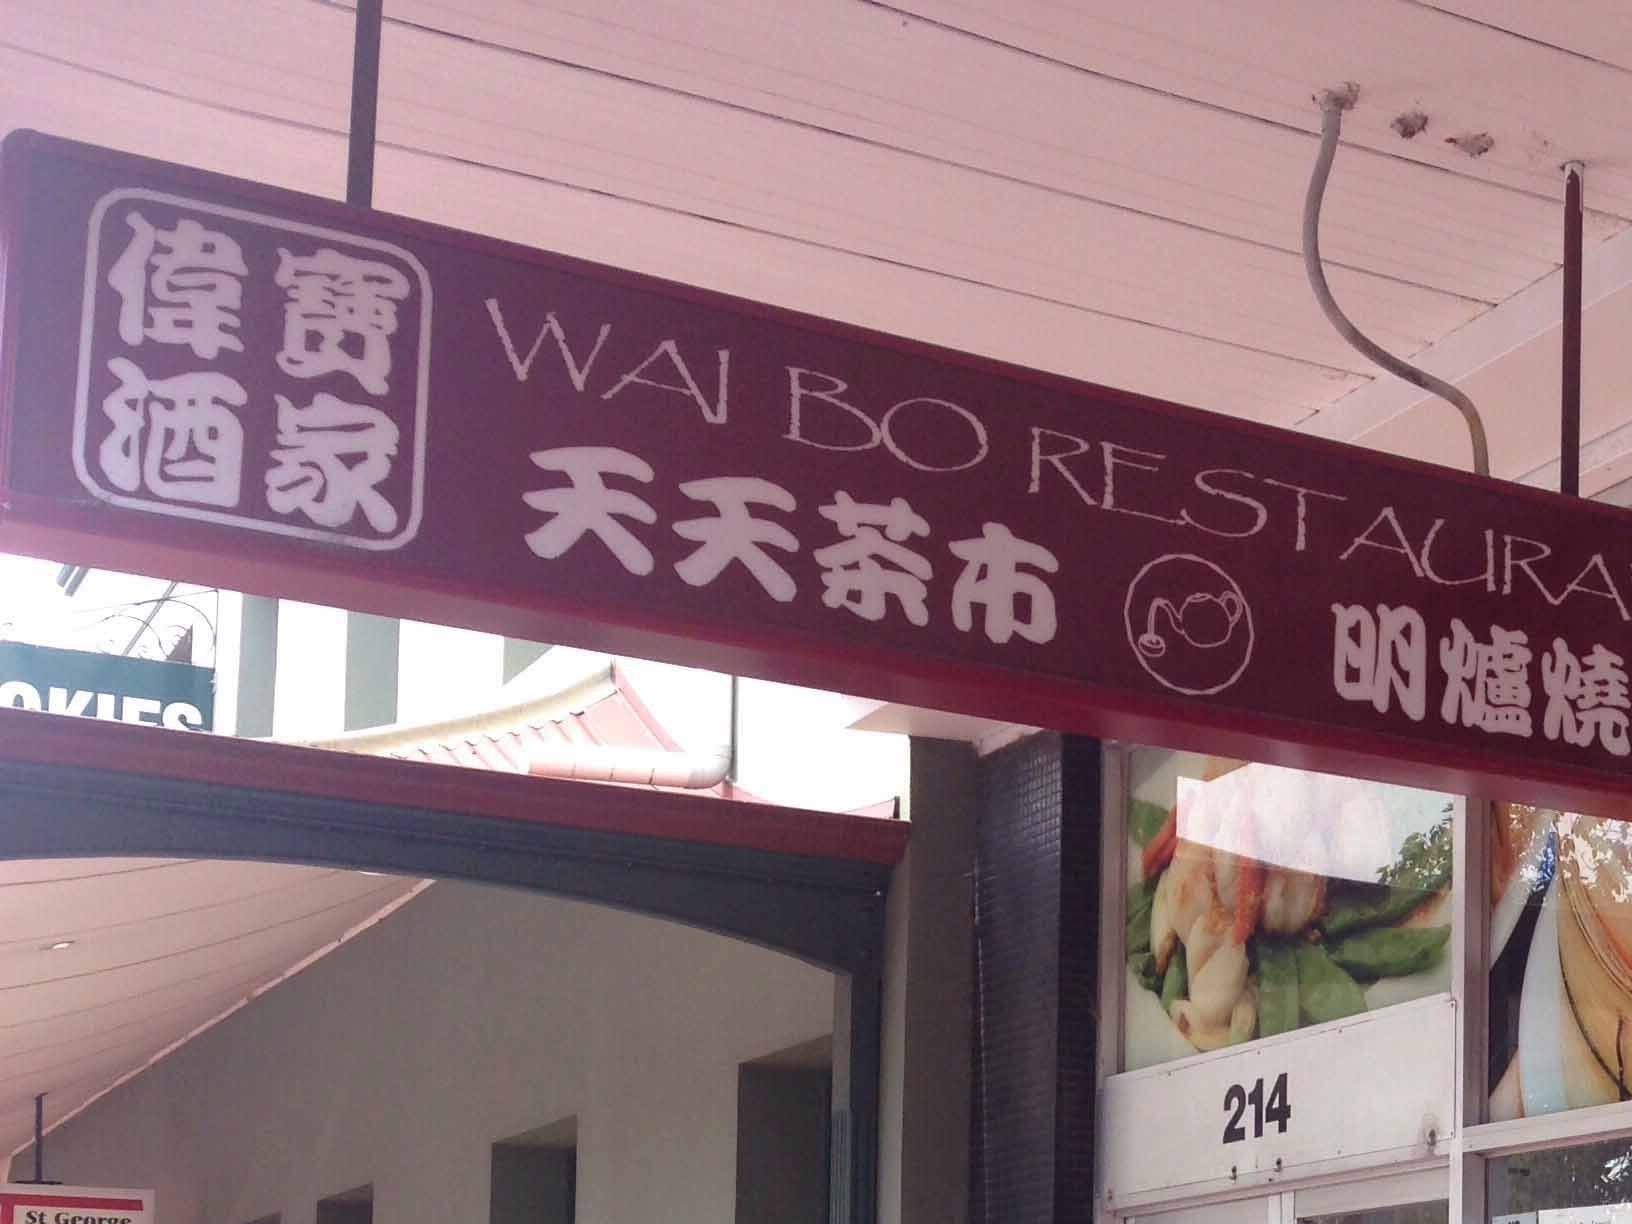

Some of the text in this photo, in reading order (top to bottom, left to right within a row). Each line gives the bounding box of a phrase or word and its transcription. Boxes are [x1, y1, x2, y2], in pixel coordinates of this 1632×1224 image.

[485, 297, 732, 426] WAI
[783, 366, 988, 473] BO
[1222, 1071, 1292, 1145] 214
[25, 1210, 47, 1224] St
